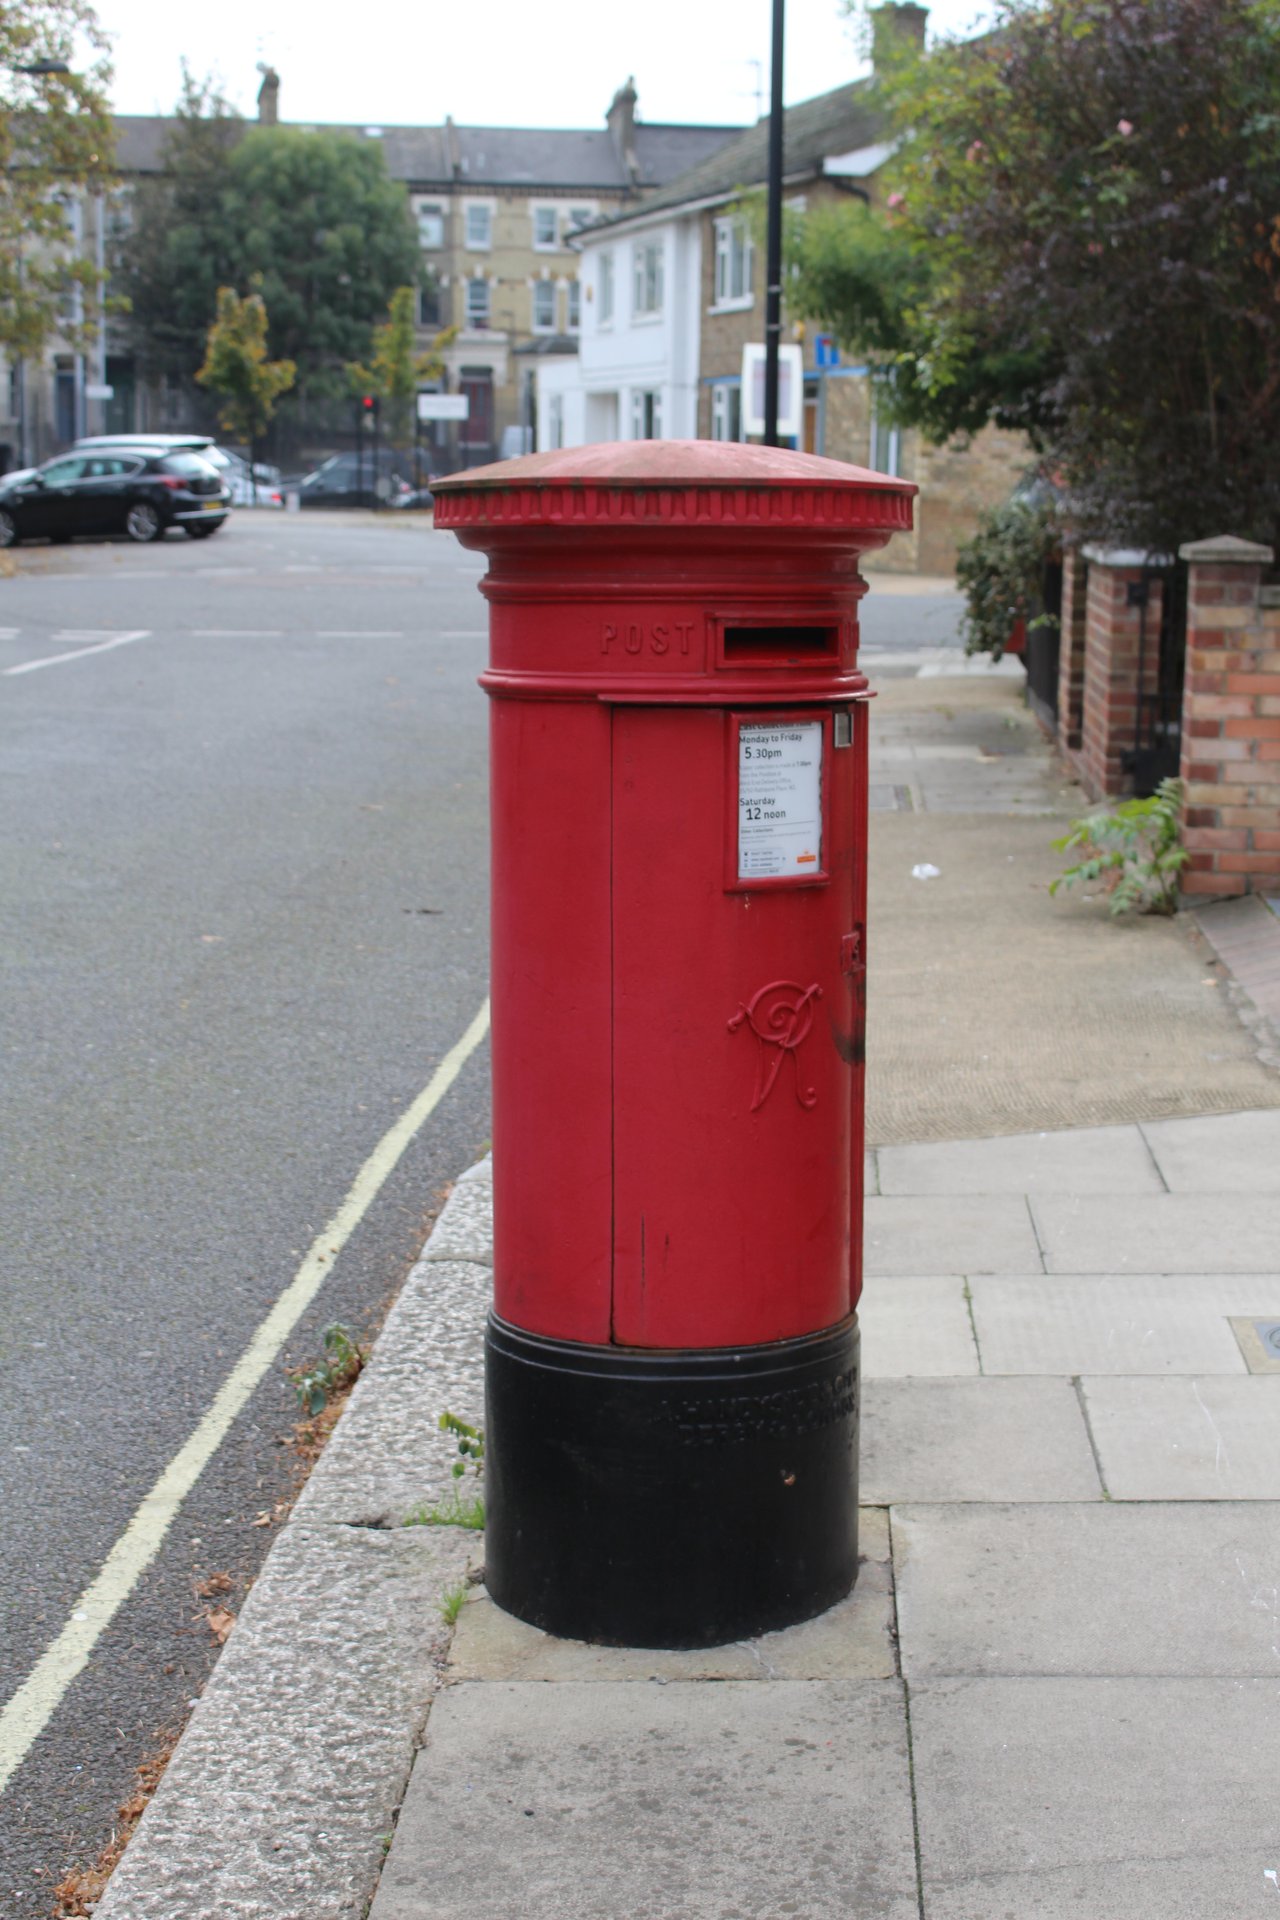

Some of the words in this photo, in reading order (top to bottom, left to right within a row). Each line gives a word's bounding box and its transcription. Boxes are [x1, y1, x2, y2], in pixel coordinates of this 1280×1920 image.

[601, 621, 695, 655] POST
[739, 735, 769, 744] Monday
[780, 733, 802, 742] Friday
[744, 746, 782, 760] 5.30pm
[740, 797, 776, 806] Saturday
[746, 807, 761, 820] 12
[764, 810, 786, 819] noon
